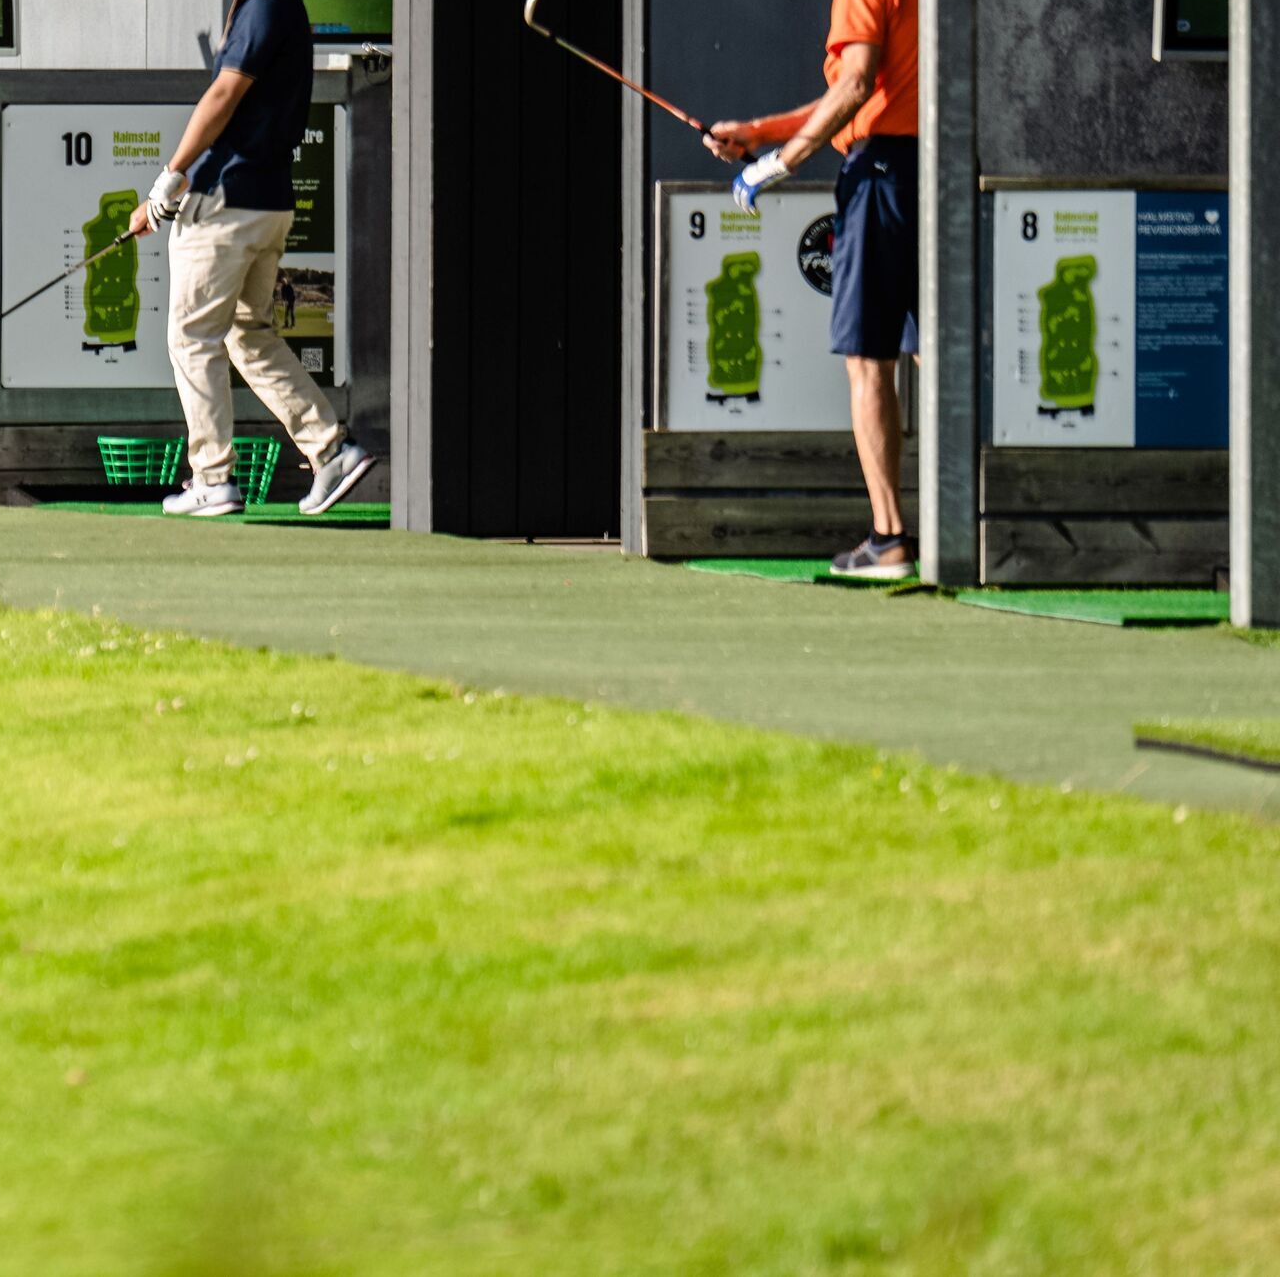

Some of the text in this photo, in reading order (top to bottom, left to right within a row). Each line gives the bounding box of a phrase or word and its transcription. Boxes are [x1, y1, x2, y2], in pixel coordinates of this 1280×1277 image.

[113, 131, 160, 143] Halmstad
[302, 128, 324, 144] tre
[62, 132, 92, 166] 10
[113, 145, 160, 157] Golfarena
[690, 211, 706, 239] 9
[1022, 211, 1038, 241] 8
